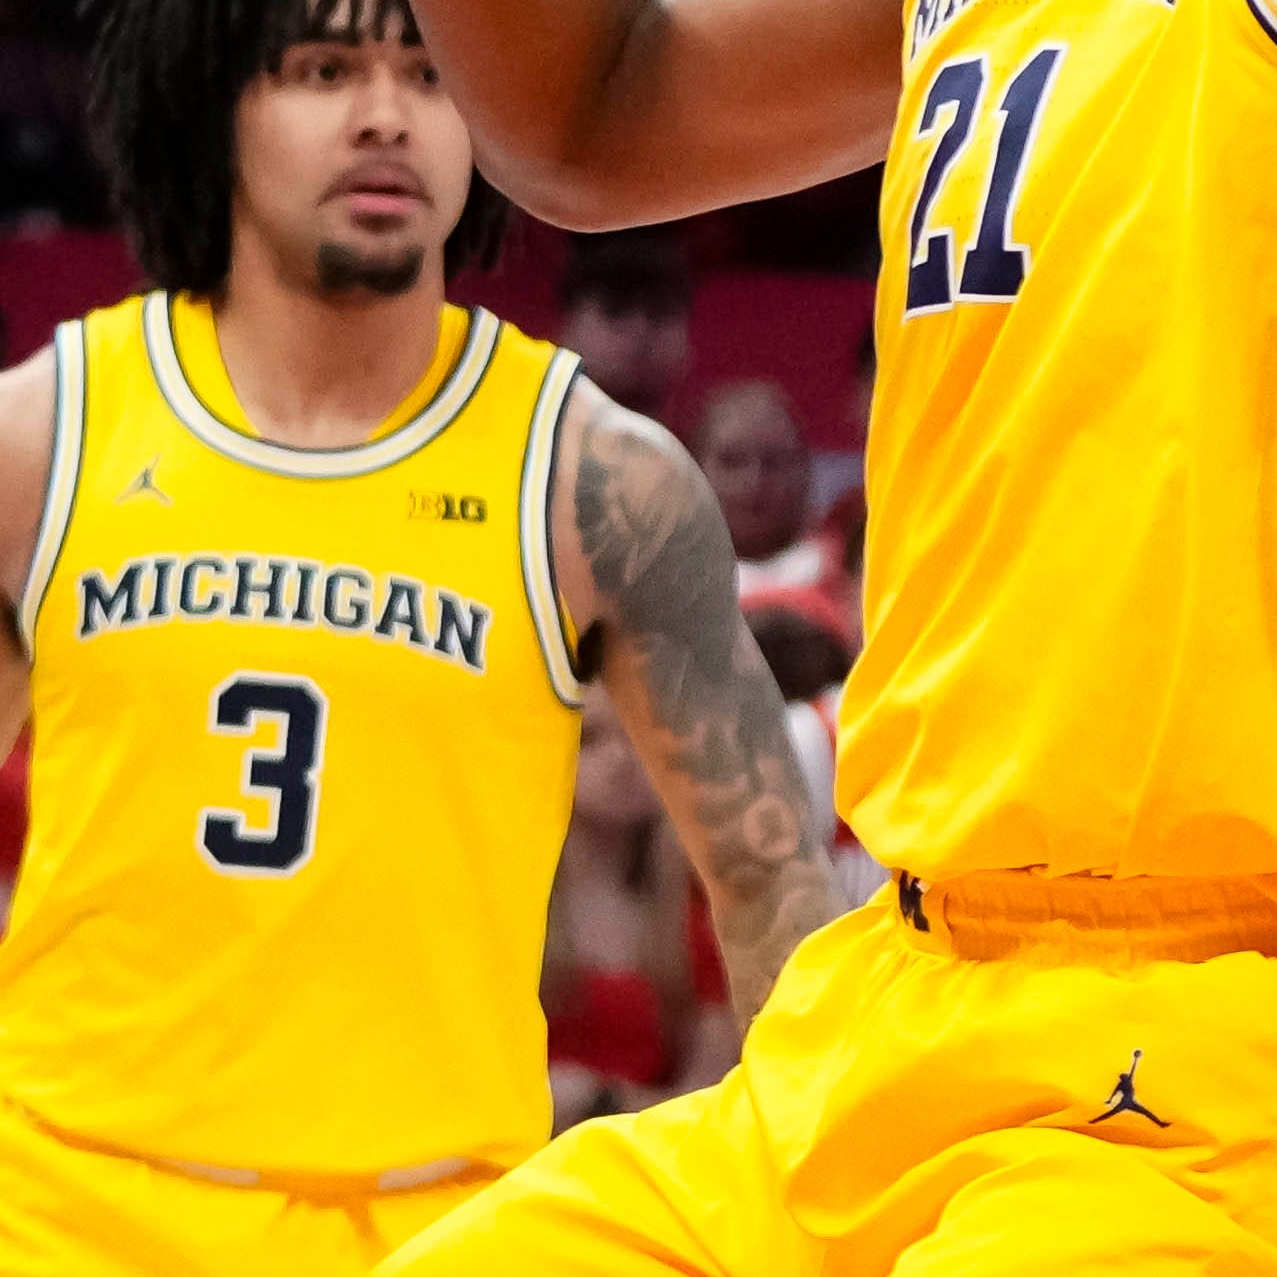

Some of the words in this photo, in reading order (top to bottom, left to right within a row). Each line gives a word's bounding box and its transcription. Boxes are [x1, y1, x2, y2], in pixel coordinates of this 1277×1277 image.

[903, 40, 1070, 324] 21
[77, 553, 491, 675] MICHIGAN
[197, 670, 328, 879] 3
